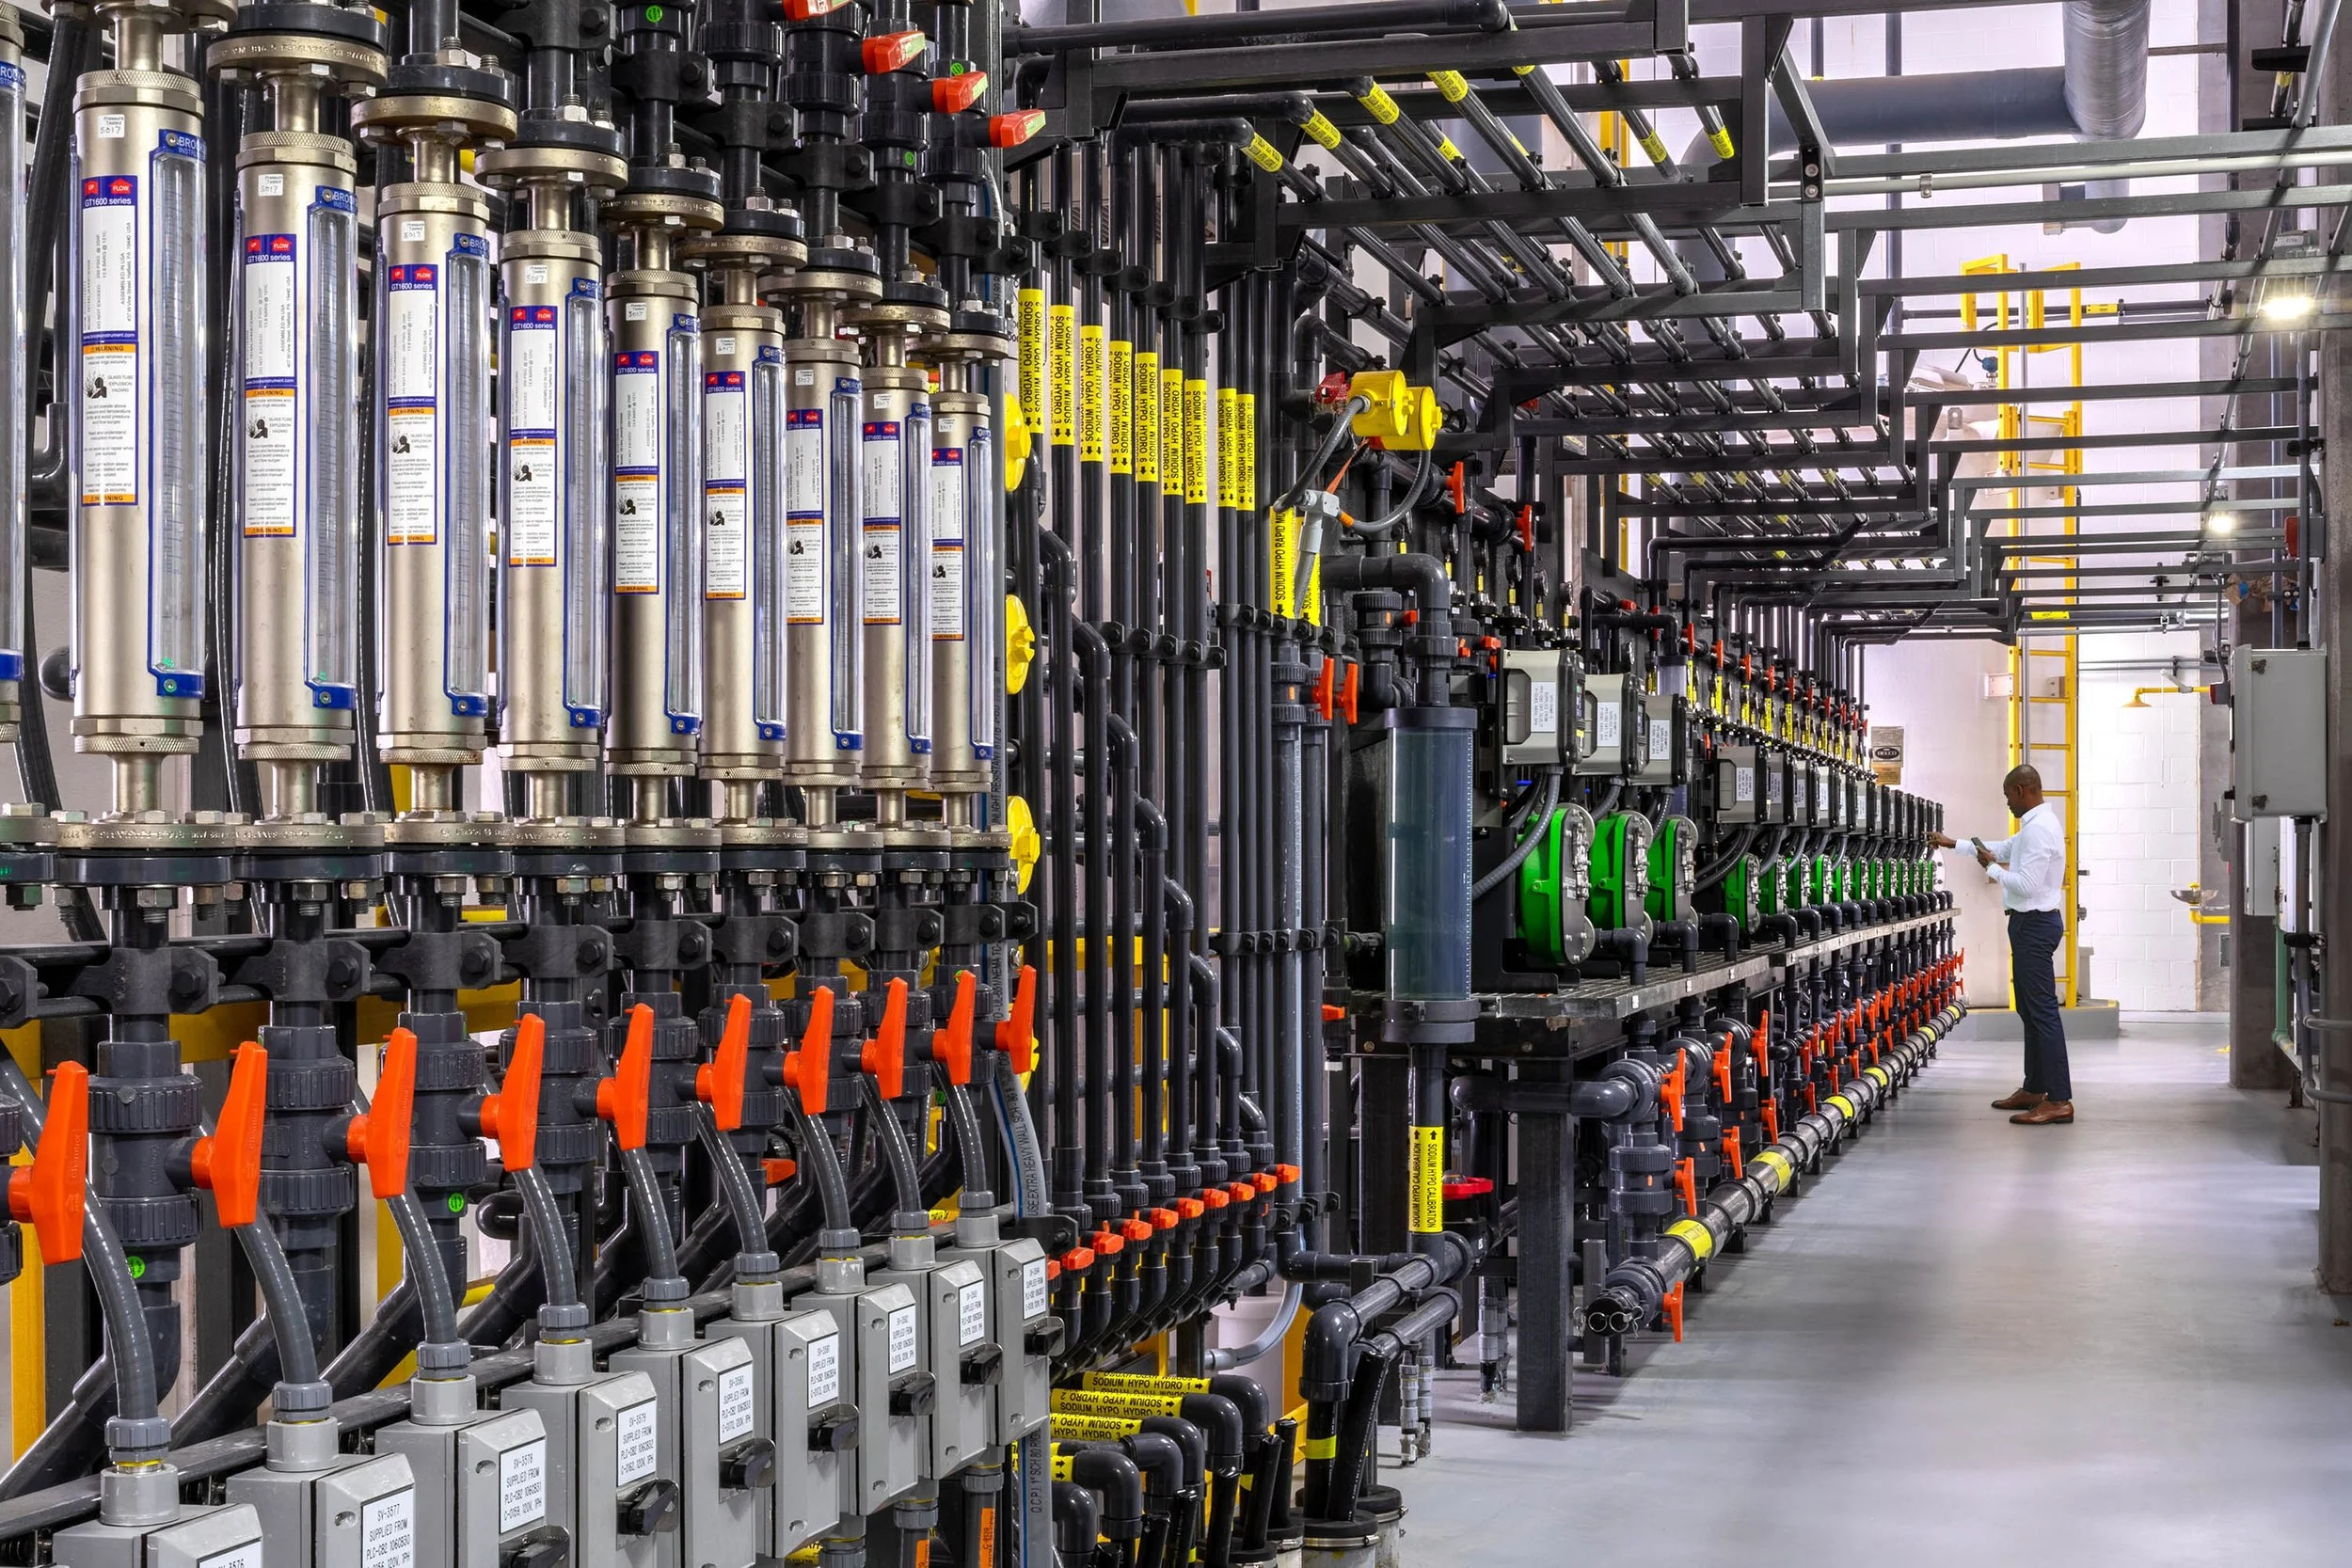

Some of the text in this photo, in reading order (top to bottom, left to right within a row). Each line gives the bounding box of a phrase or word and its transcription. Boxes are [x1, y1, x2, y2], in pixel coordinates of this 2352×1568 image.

[1024, 301, 1033, 337] SODIUM
[1056, 315, 1065, 349] SODIUM
[1024, 342, 1032, 367] HYPO
[1055, 354, 1063, 378] HYPO
[1114, 351, 1122, 383] SODIUM
[1024, 372, 1032, 403] HYDRO
[1054, 384, 1063, 414] HYDRO
[1112, 388, 1120, 411] HYPO
[1276, 526, 1285, 600] SODIUM HYPO RAPID
[1016, 1123, 1039, 1217] USE EXTRA HEAVY WALL
[1412, 1144, 1421, 1227] SODIUM HYPO CALIBRATION
[1426, 1144, 1437, 1228] SODIUM HYPO CALIBRATION
[1092, 1378, 1124, 1387] SODIUM
[1153, 1381, 1182, 1389] HYDRO
[1060, 1402, 1092, 1411] SODIUM
[1096, 1404, 1120, 1415] HYPO
[1123, 1406, 1152, 1416] HYDRO
[1070, 1394, 1098, 1403] HYDRO
[1130, 1398, 1162, 1408] SODIUM
[623, 1425, 652, 1444] SUPPLIED FROM
[1054, 1428, 1077, 1437] HYPO
[1082, 1430, 1112, 1438] HYDRO
[1061, 1418, 1121, 1429] SODIUM HYPO
[506, 1466, 540, 1488] SUPPLIED FROM
[377, 1503, 400, 1522] SV-3577
[370, 1518, 407, 1542] SUPPLIED FROM
